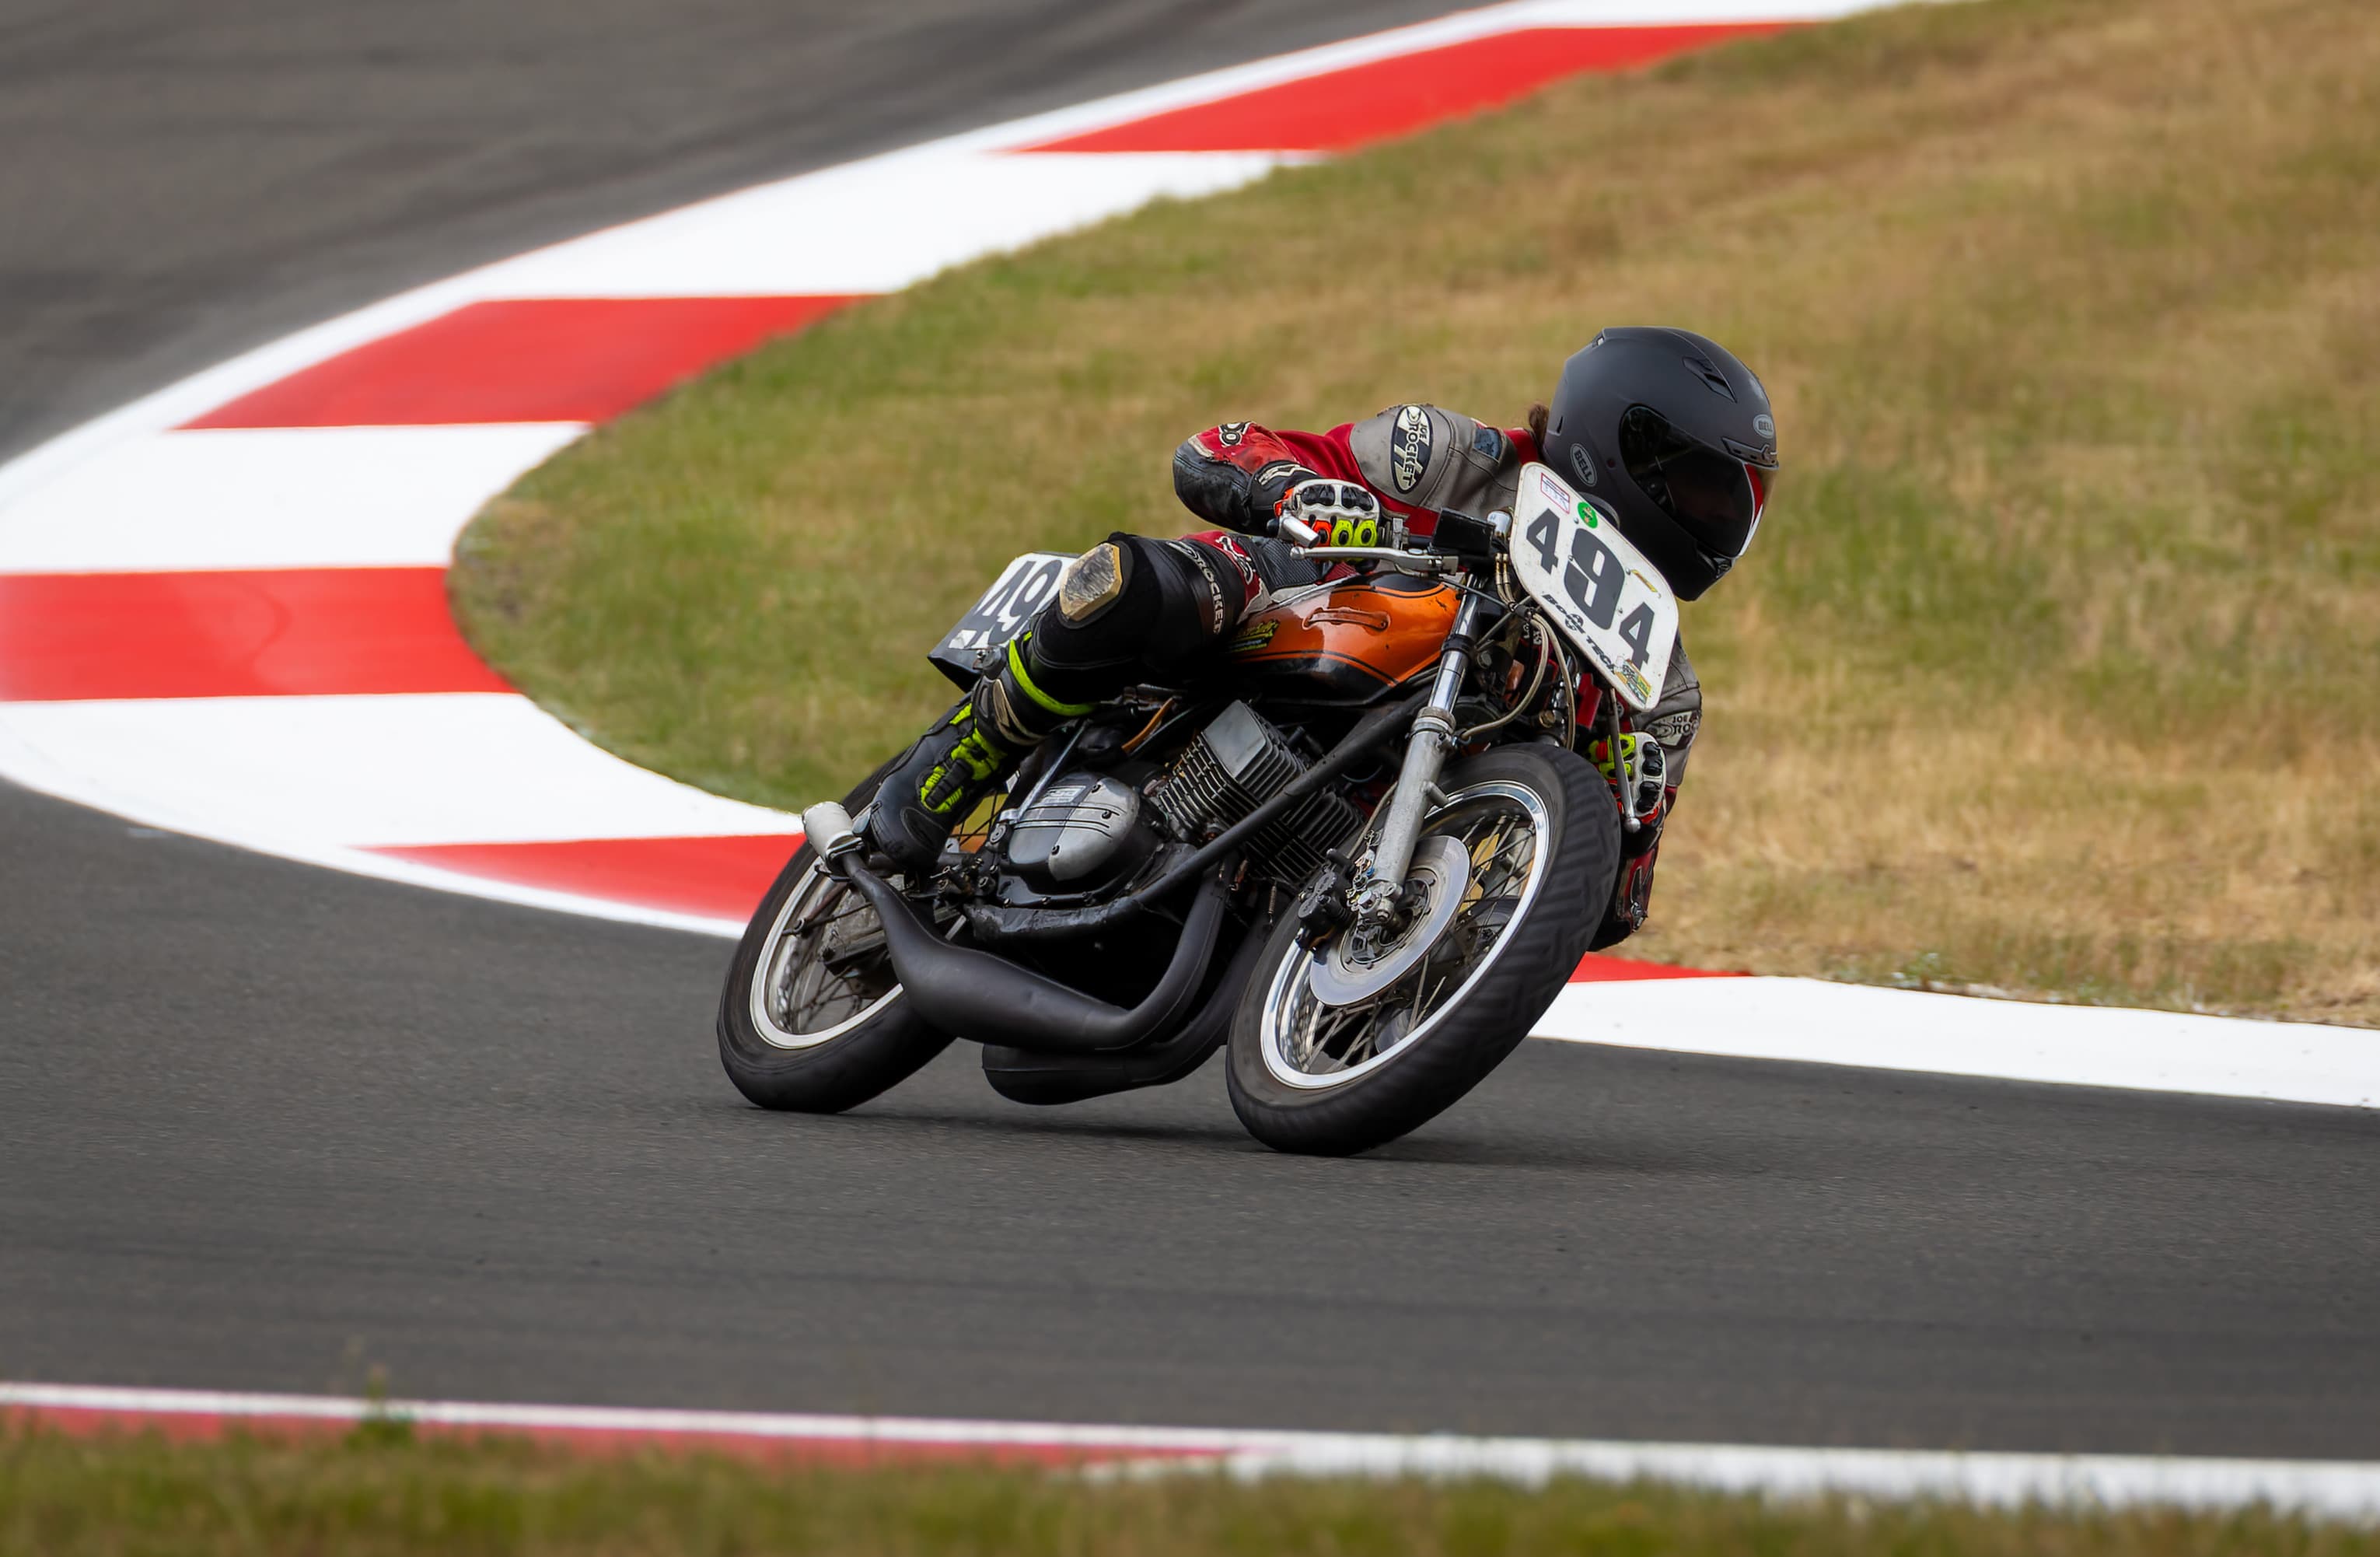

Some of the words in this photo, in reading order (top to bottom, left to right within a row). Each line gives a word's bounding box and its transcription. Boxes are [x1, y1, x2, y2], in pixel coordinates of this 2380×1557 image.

[1403, 423, 1419, 486] ROCKET
[1419, 423, 1428, 440] JOE
[1574, 449, 1592, 481] BELL
[1197, 558, 1224, 635] ROCKET
[1526, 508, 1655, 670] 494
